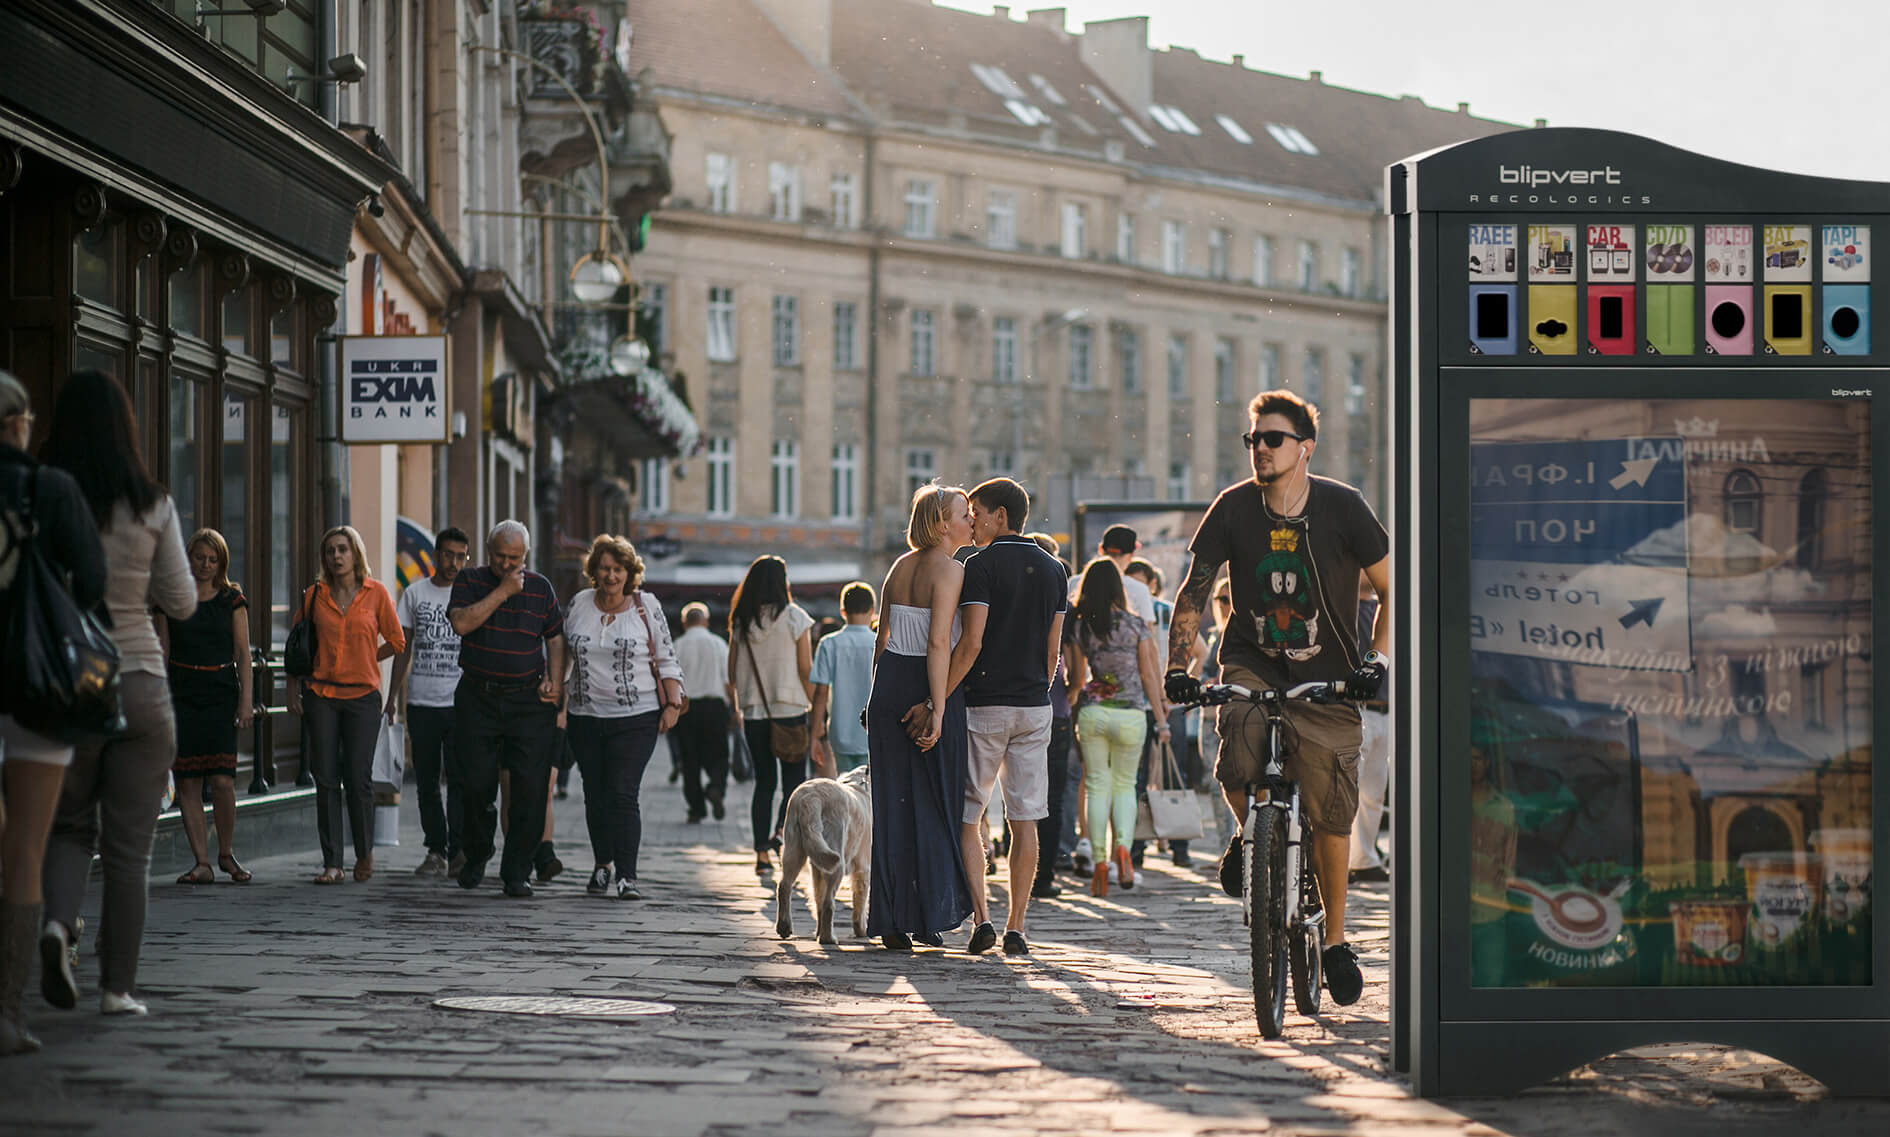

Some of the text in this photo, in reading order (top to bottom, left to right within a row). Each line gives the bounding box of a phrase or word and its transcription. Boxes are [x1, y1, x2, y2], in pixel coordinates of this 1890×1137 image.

[1499, 165, 1621, 188] blipvert
[1469, 194, 1651, 204] RECOLOGICS
[1469, 226, 1513, 245] RAEE
[1764, 226, 1795, 245] BAT
[1823, 226, 1862, 245] TAPL
[367, 361, 423, 372] UKR
[351, 376, 437, 403] EXIM
[1832, 388, 1872, 397] blipvert
[351, 405, 438, 419] BANK
[1745, 633, 1863, 673] ніжною
